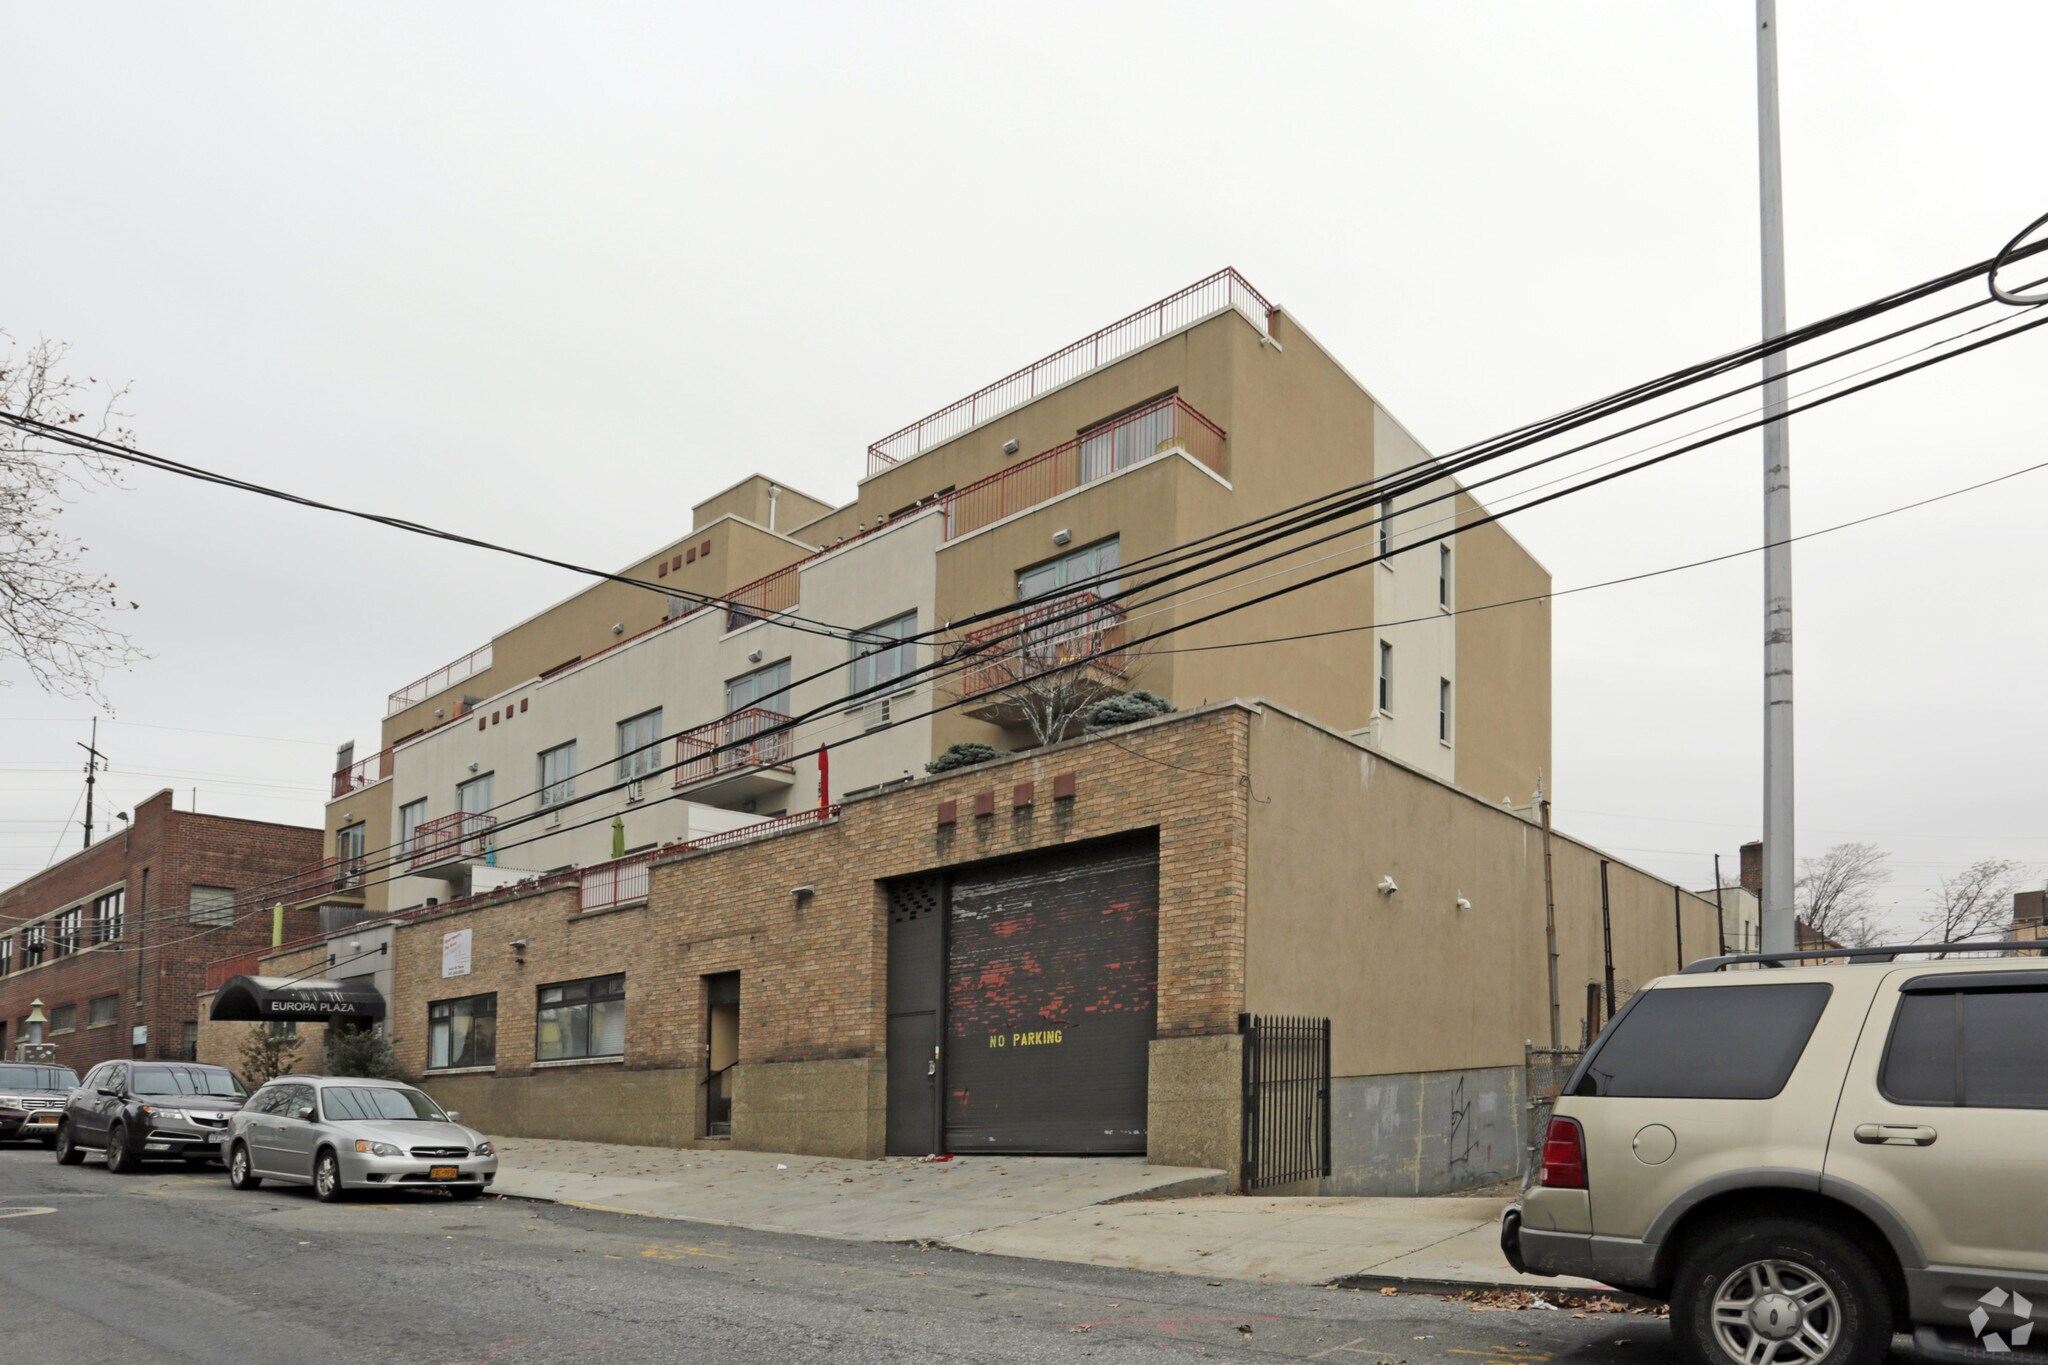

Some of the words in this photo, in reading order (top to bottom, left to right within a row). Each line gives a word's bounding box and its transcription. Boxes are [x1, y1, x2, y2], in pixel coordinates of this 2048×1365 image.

[271, 1001, 316, 1011] EUROPA
[320, 1003, 355, 1012] PLAZA
[990, 1035, 1005, 1048] NO
[1013, 1030, 1062, 1046] PARKING
